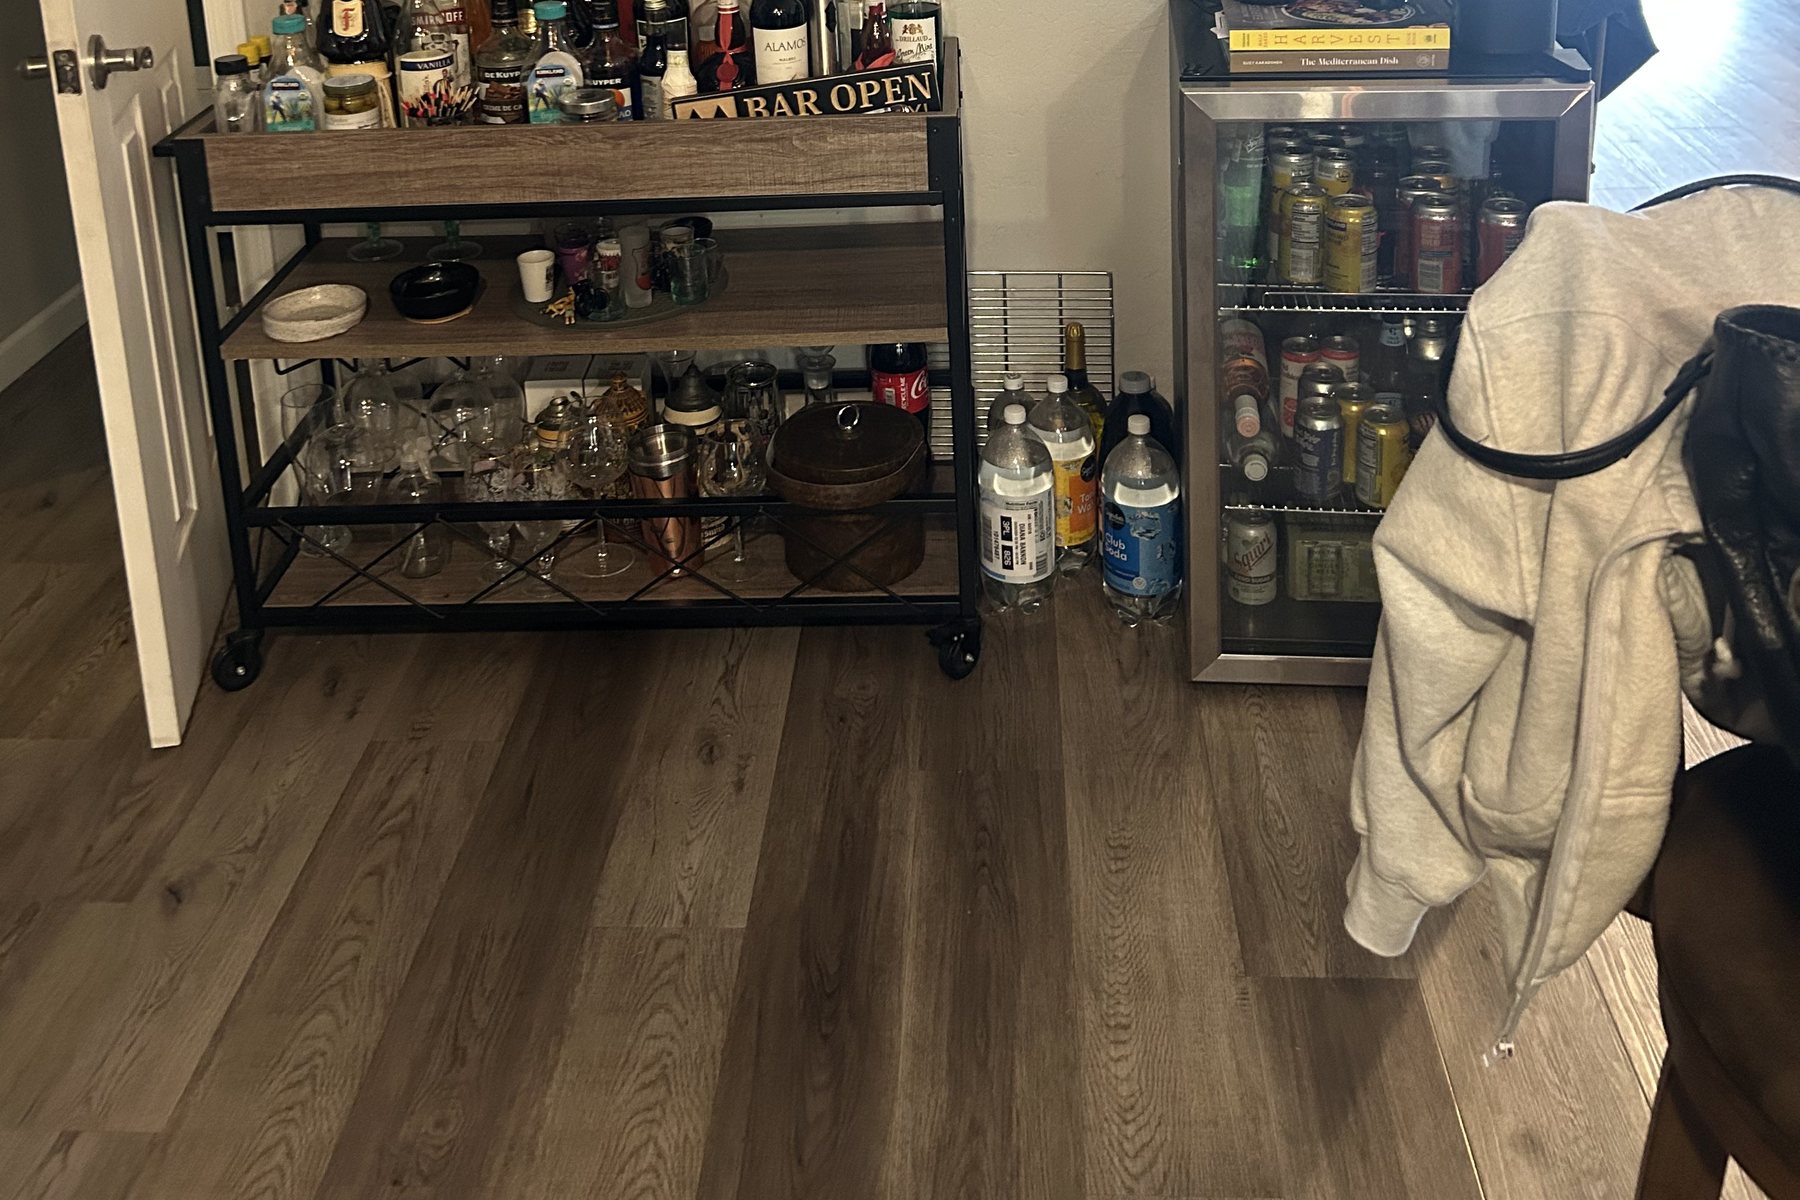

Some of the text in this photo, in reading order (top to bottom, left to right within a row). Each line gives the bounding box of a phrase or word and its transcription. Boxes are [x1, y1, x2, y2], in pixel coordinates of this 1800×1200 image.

[764, 38, 807, 52] ALAMOS
[1275, 34, 1400, 45] HARVEST
[417, 57, 451, 71] VANILLA
[1301, 56, 1399, 67] The Mediterranean Dish
[744, 71, 932, 118] BAR OPEN
[1104, 532, 1126, 550] Club
[1003, 549, 1012, 566] 826
[1104, 544, 1128, 561] Soda
[1234, 531, 1272, 571] Squirt
